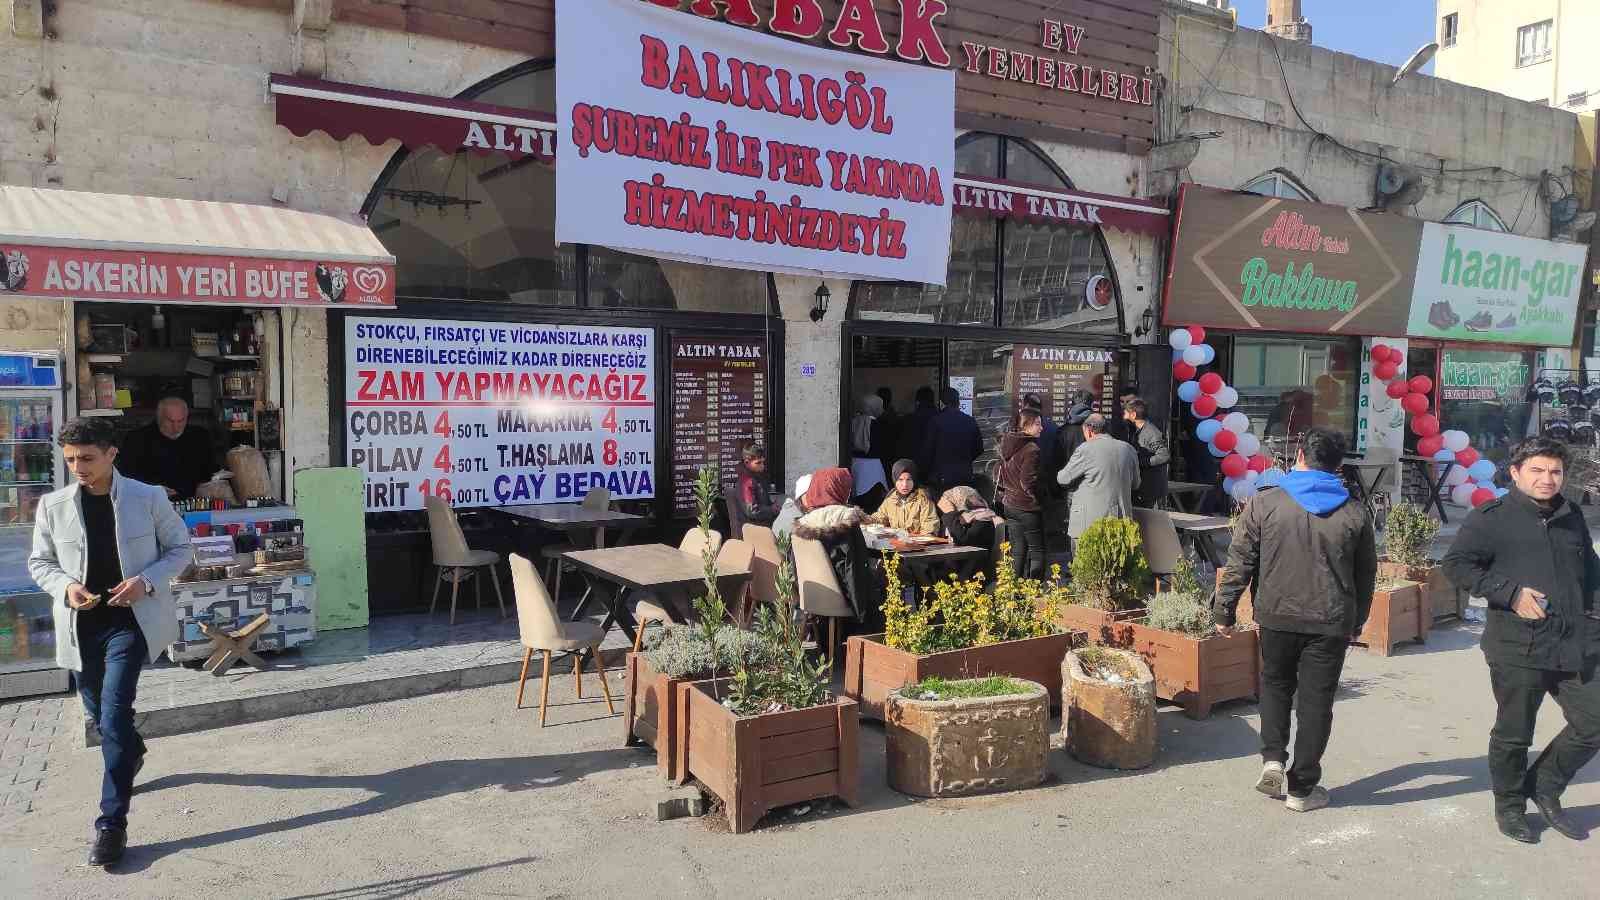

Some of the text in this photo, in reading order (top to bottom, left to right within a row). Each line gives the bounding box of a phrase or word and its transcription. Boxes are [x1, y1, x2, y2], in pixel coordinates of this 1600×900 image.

[1043, 19, 1085, 55] EV
[640, 34, 893, 135] BALIKLIGÖL
[962, 41, 1152, 105] YEMEKLERİ
[572, 102, 944, 206] ŞUBEMİZ İLE PEK YAKINDA
[624, 173, 907, 259] HİZMETİNİZDEYİZ
[1026, 196, 1102, 224] TABAK
[44, 258, 309, 299] ASKERİN YERİ BÜFE
[1241, 257, 1359, 312] Baklava
[1441, 233, 1580, 307] haan-gar
[356, 324, 647, 350] STOKÇU, FIRSATÇI VE VİCDANSIZLARA KARŞI
[677, 345, 761, 358] ALTIN TABAK
[356, 344, 647, 368] DİRENEBİLECEĞİMİZ KADAR DİRENECEĞİZ
[1022, 347, 1113, 362] ALTIN TABAK
[357, 368, 647, 401] ZAM YAPMAYACAĞIZ
[351, 410, 428, 442] ÇORBA
[474, 423, 488, 437] TL
[497, 409, 592, 432] MAKARNA
[639, 420, 651, 432] TL
[352, 442, 423, 472] PİLAV
[475, 458, 488, 471] TL
[496, 443, 594, 472] T.HAŞLAMA
[639, 452, 651, 464] TL
[362, 477, 409, 507] İRİT
[475, 489, 488, 502] TL
[493, 474, 547, 504] ÇAY
[555, 471, 652, 498] BEDAVA
